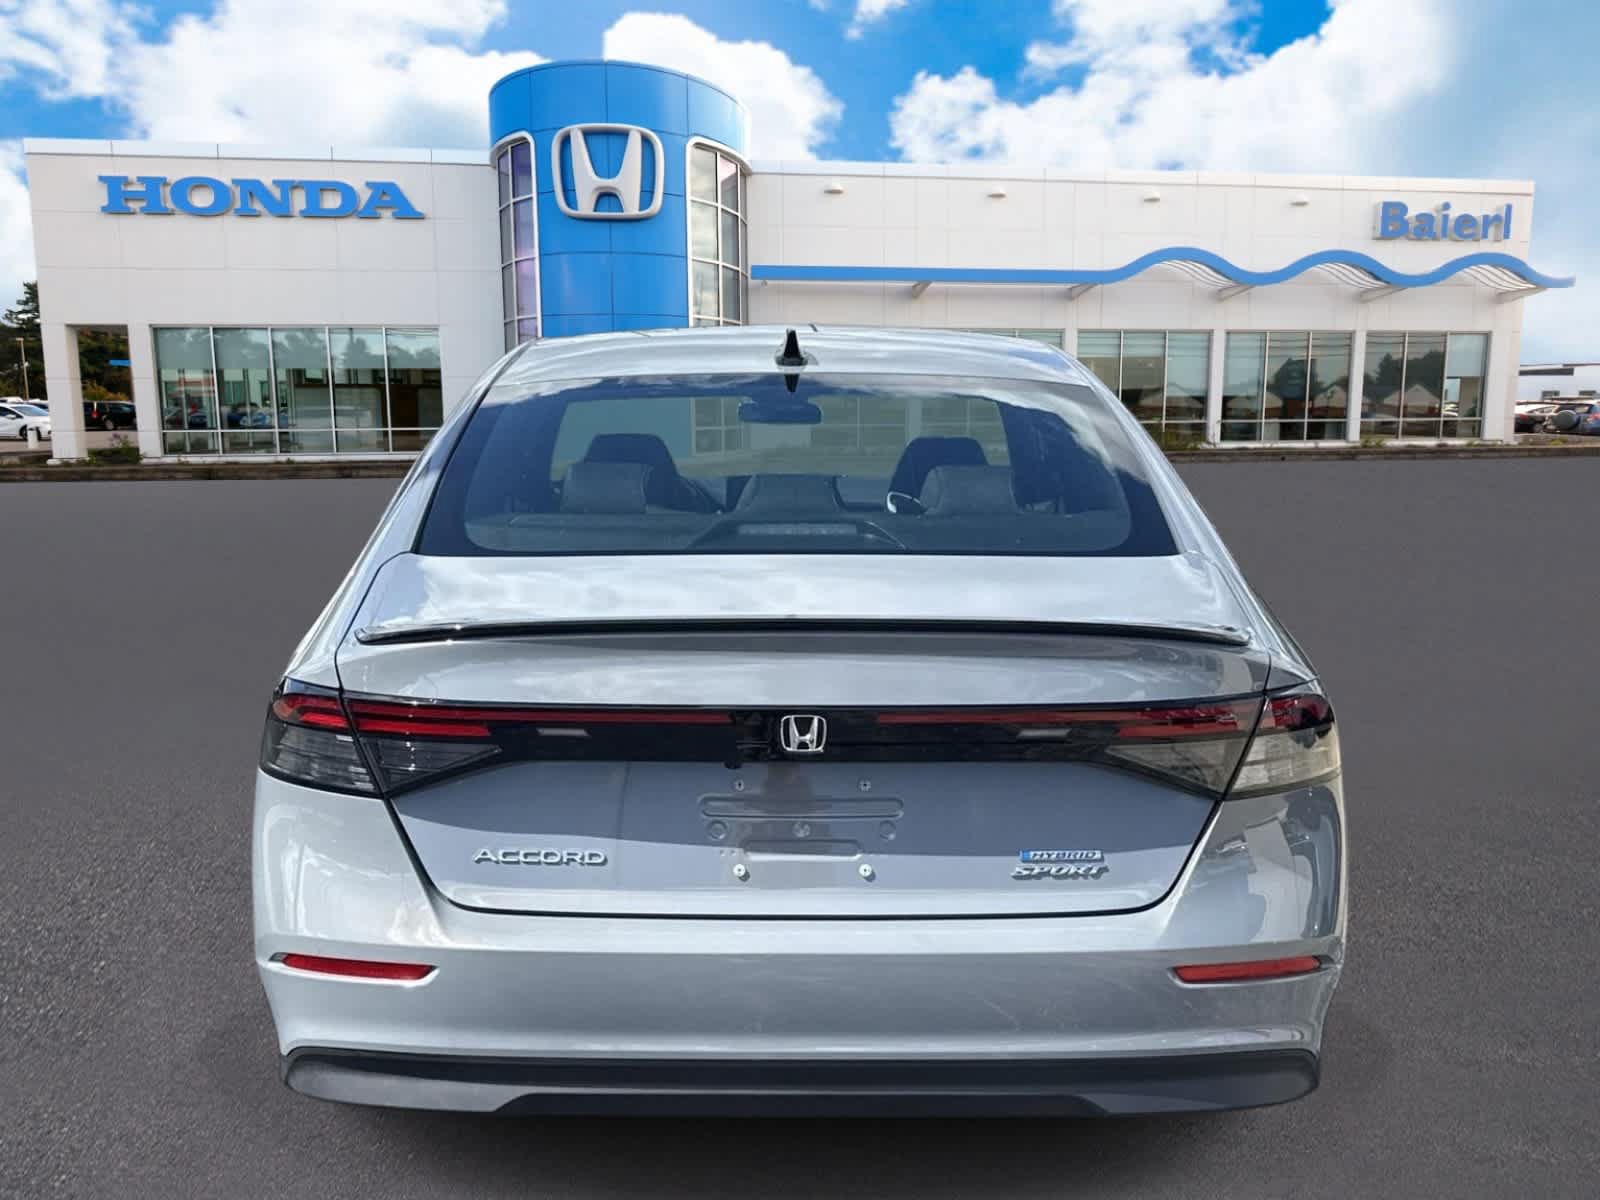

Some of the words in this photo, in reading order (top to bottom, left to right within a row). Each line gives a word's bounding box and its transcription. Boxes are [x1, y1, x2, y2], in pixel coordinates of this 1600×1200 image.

[97, 175, 425, 219] HONDA
[1377, 200, 1513, 240] Baierl
[474, 848, 608, 866] ACCORD
[1028, 849, 1102, 862] HYBRID
[1011, 864, 1108, 879] SPORT
